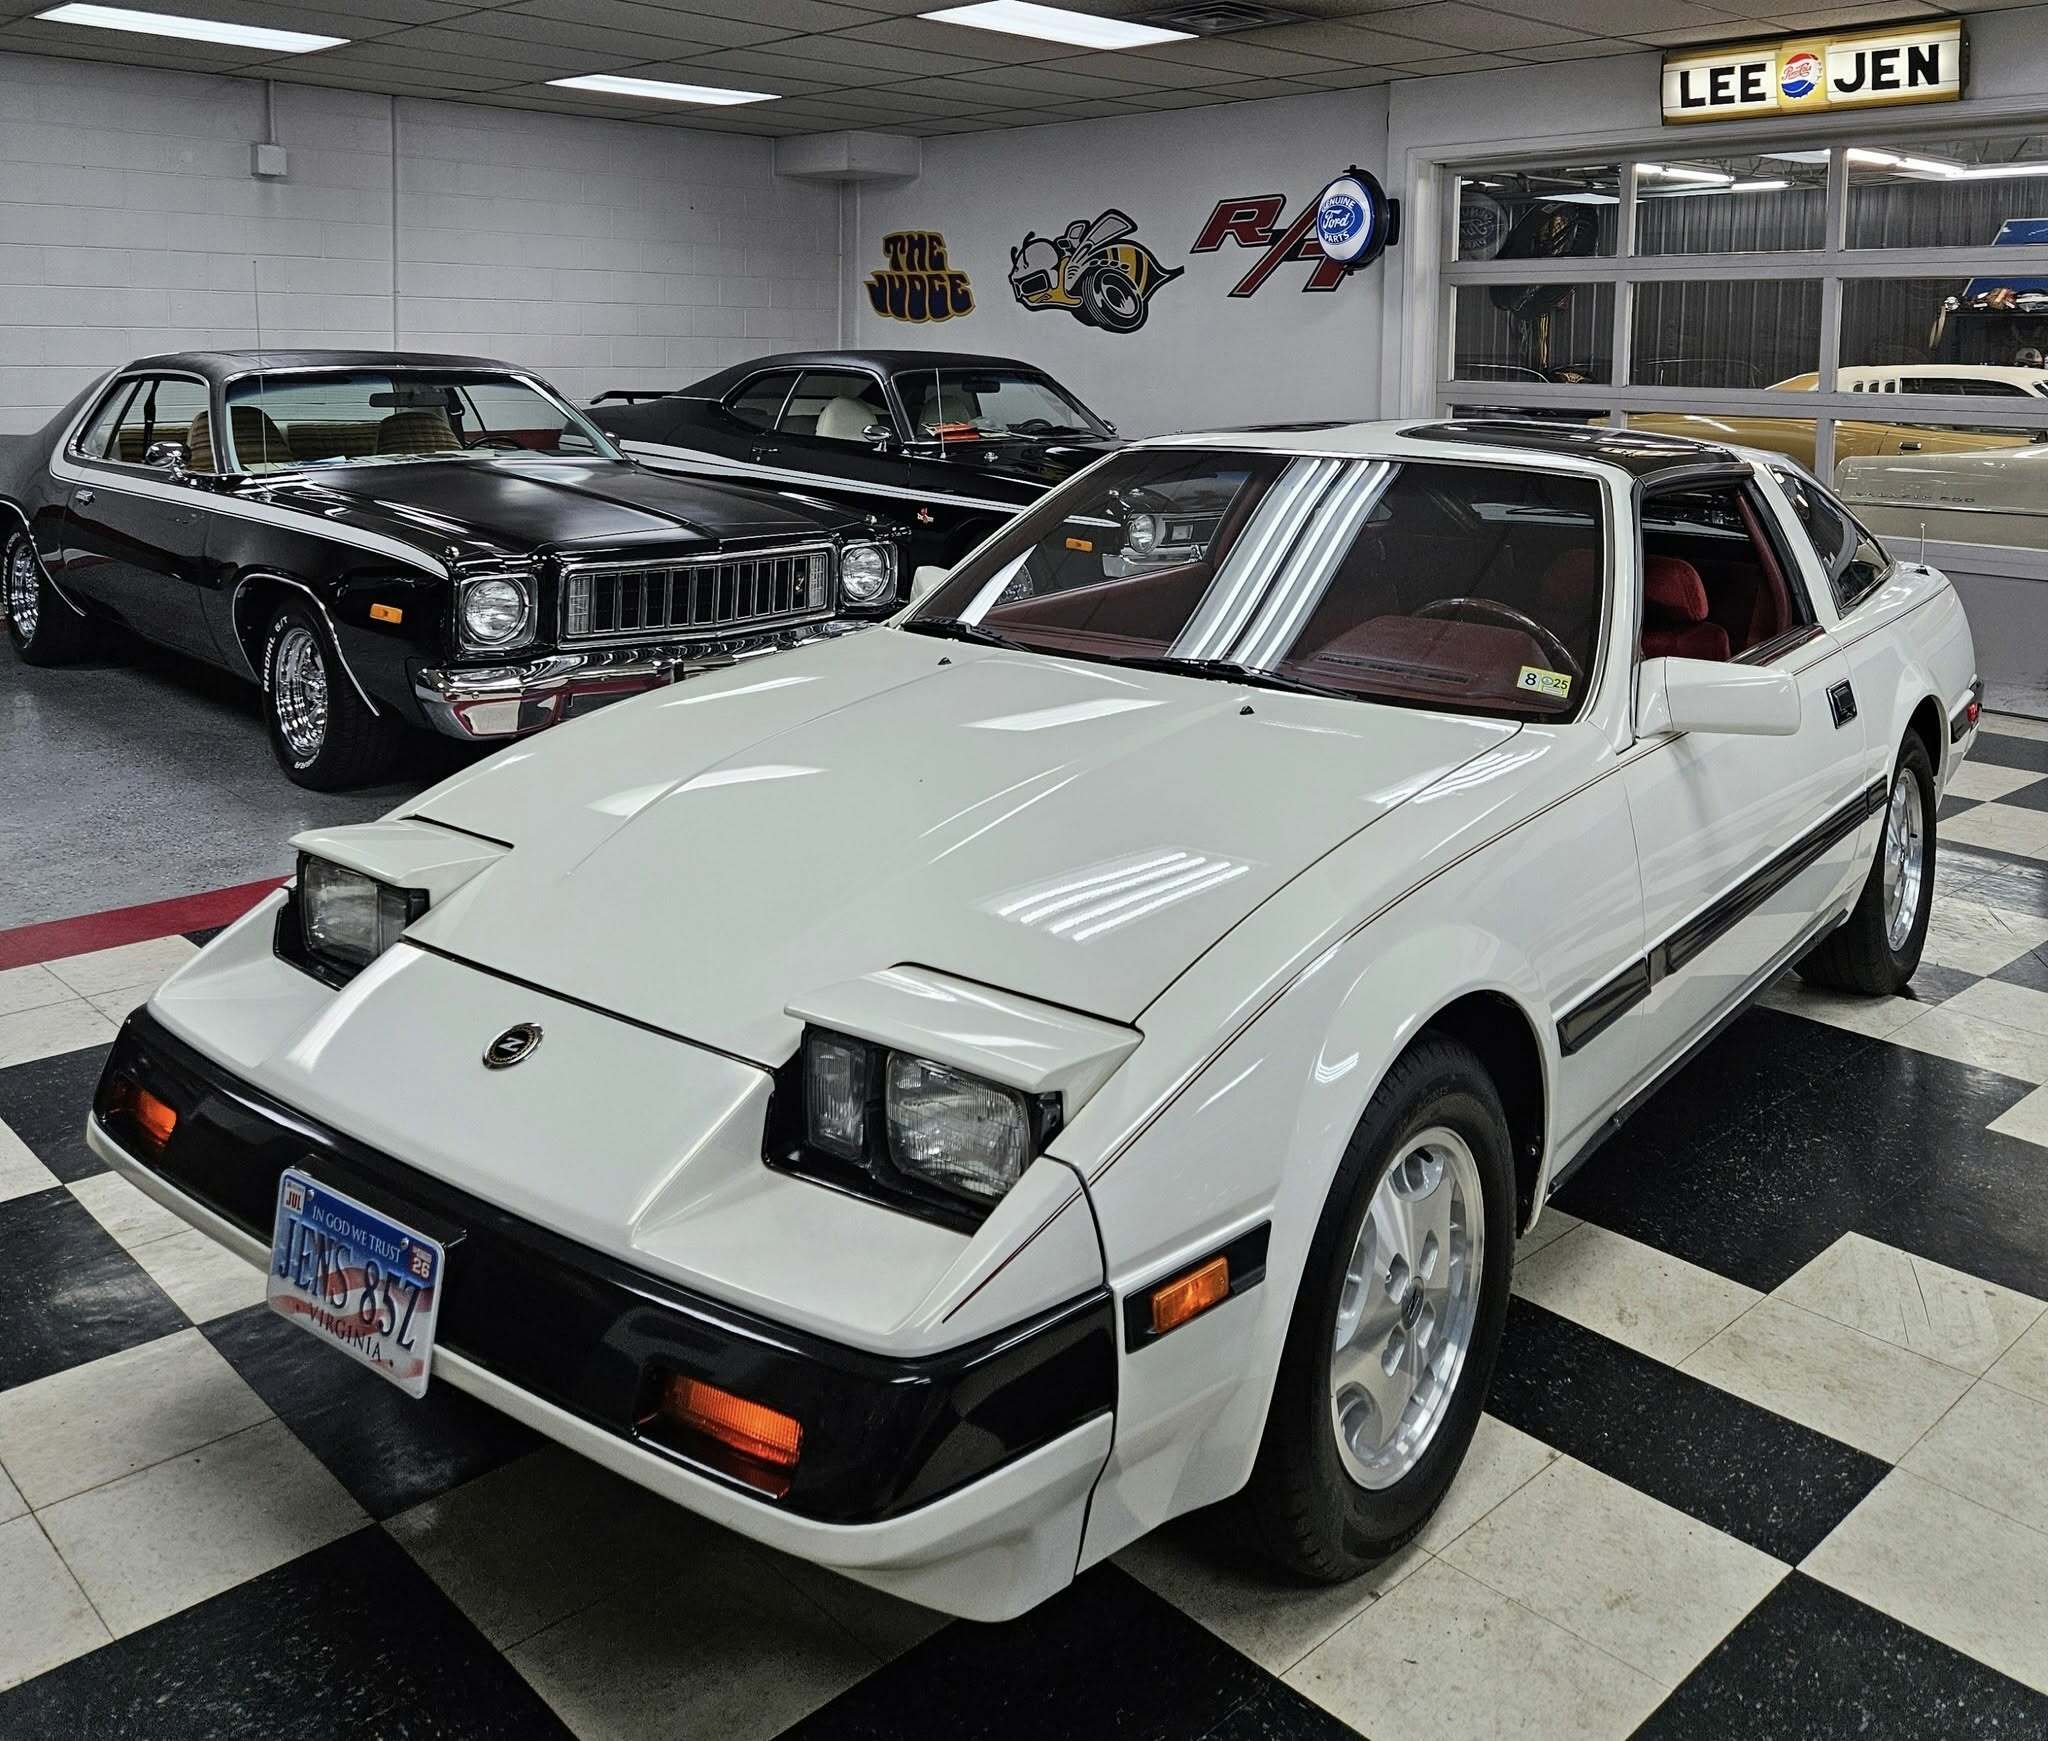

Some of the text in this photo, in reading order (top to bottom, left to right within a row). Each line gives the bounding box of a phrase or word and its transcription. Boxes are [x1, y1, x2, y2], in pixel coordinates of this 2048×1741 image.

[1680, 43, 1940, 109] LEE JEN
[1321, 196, 1356, 212] GENUINE
[1322, 209, 1351, 229] Ford
[882, 231, 948, 272] THE
[1324, 231, 1350, 243] PARTS
[863, 270, 976, 324] JUDGE
[1525, 673, 1568, 690] 8 25
[286, 1191, 302, 1210] JUL
[312, 1205, 325, 1223] IN
[326, 1212, 350, 1236] GOD
[352, 1225, 368, 1247] WE
[369, 1236, 402, 1263] TRUST
[278, 1217, 355, 1310] JENS
[412, 1257, 430, 1279] 26
[308, 1305, 382, 1361] VIRGINIA
